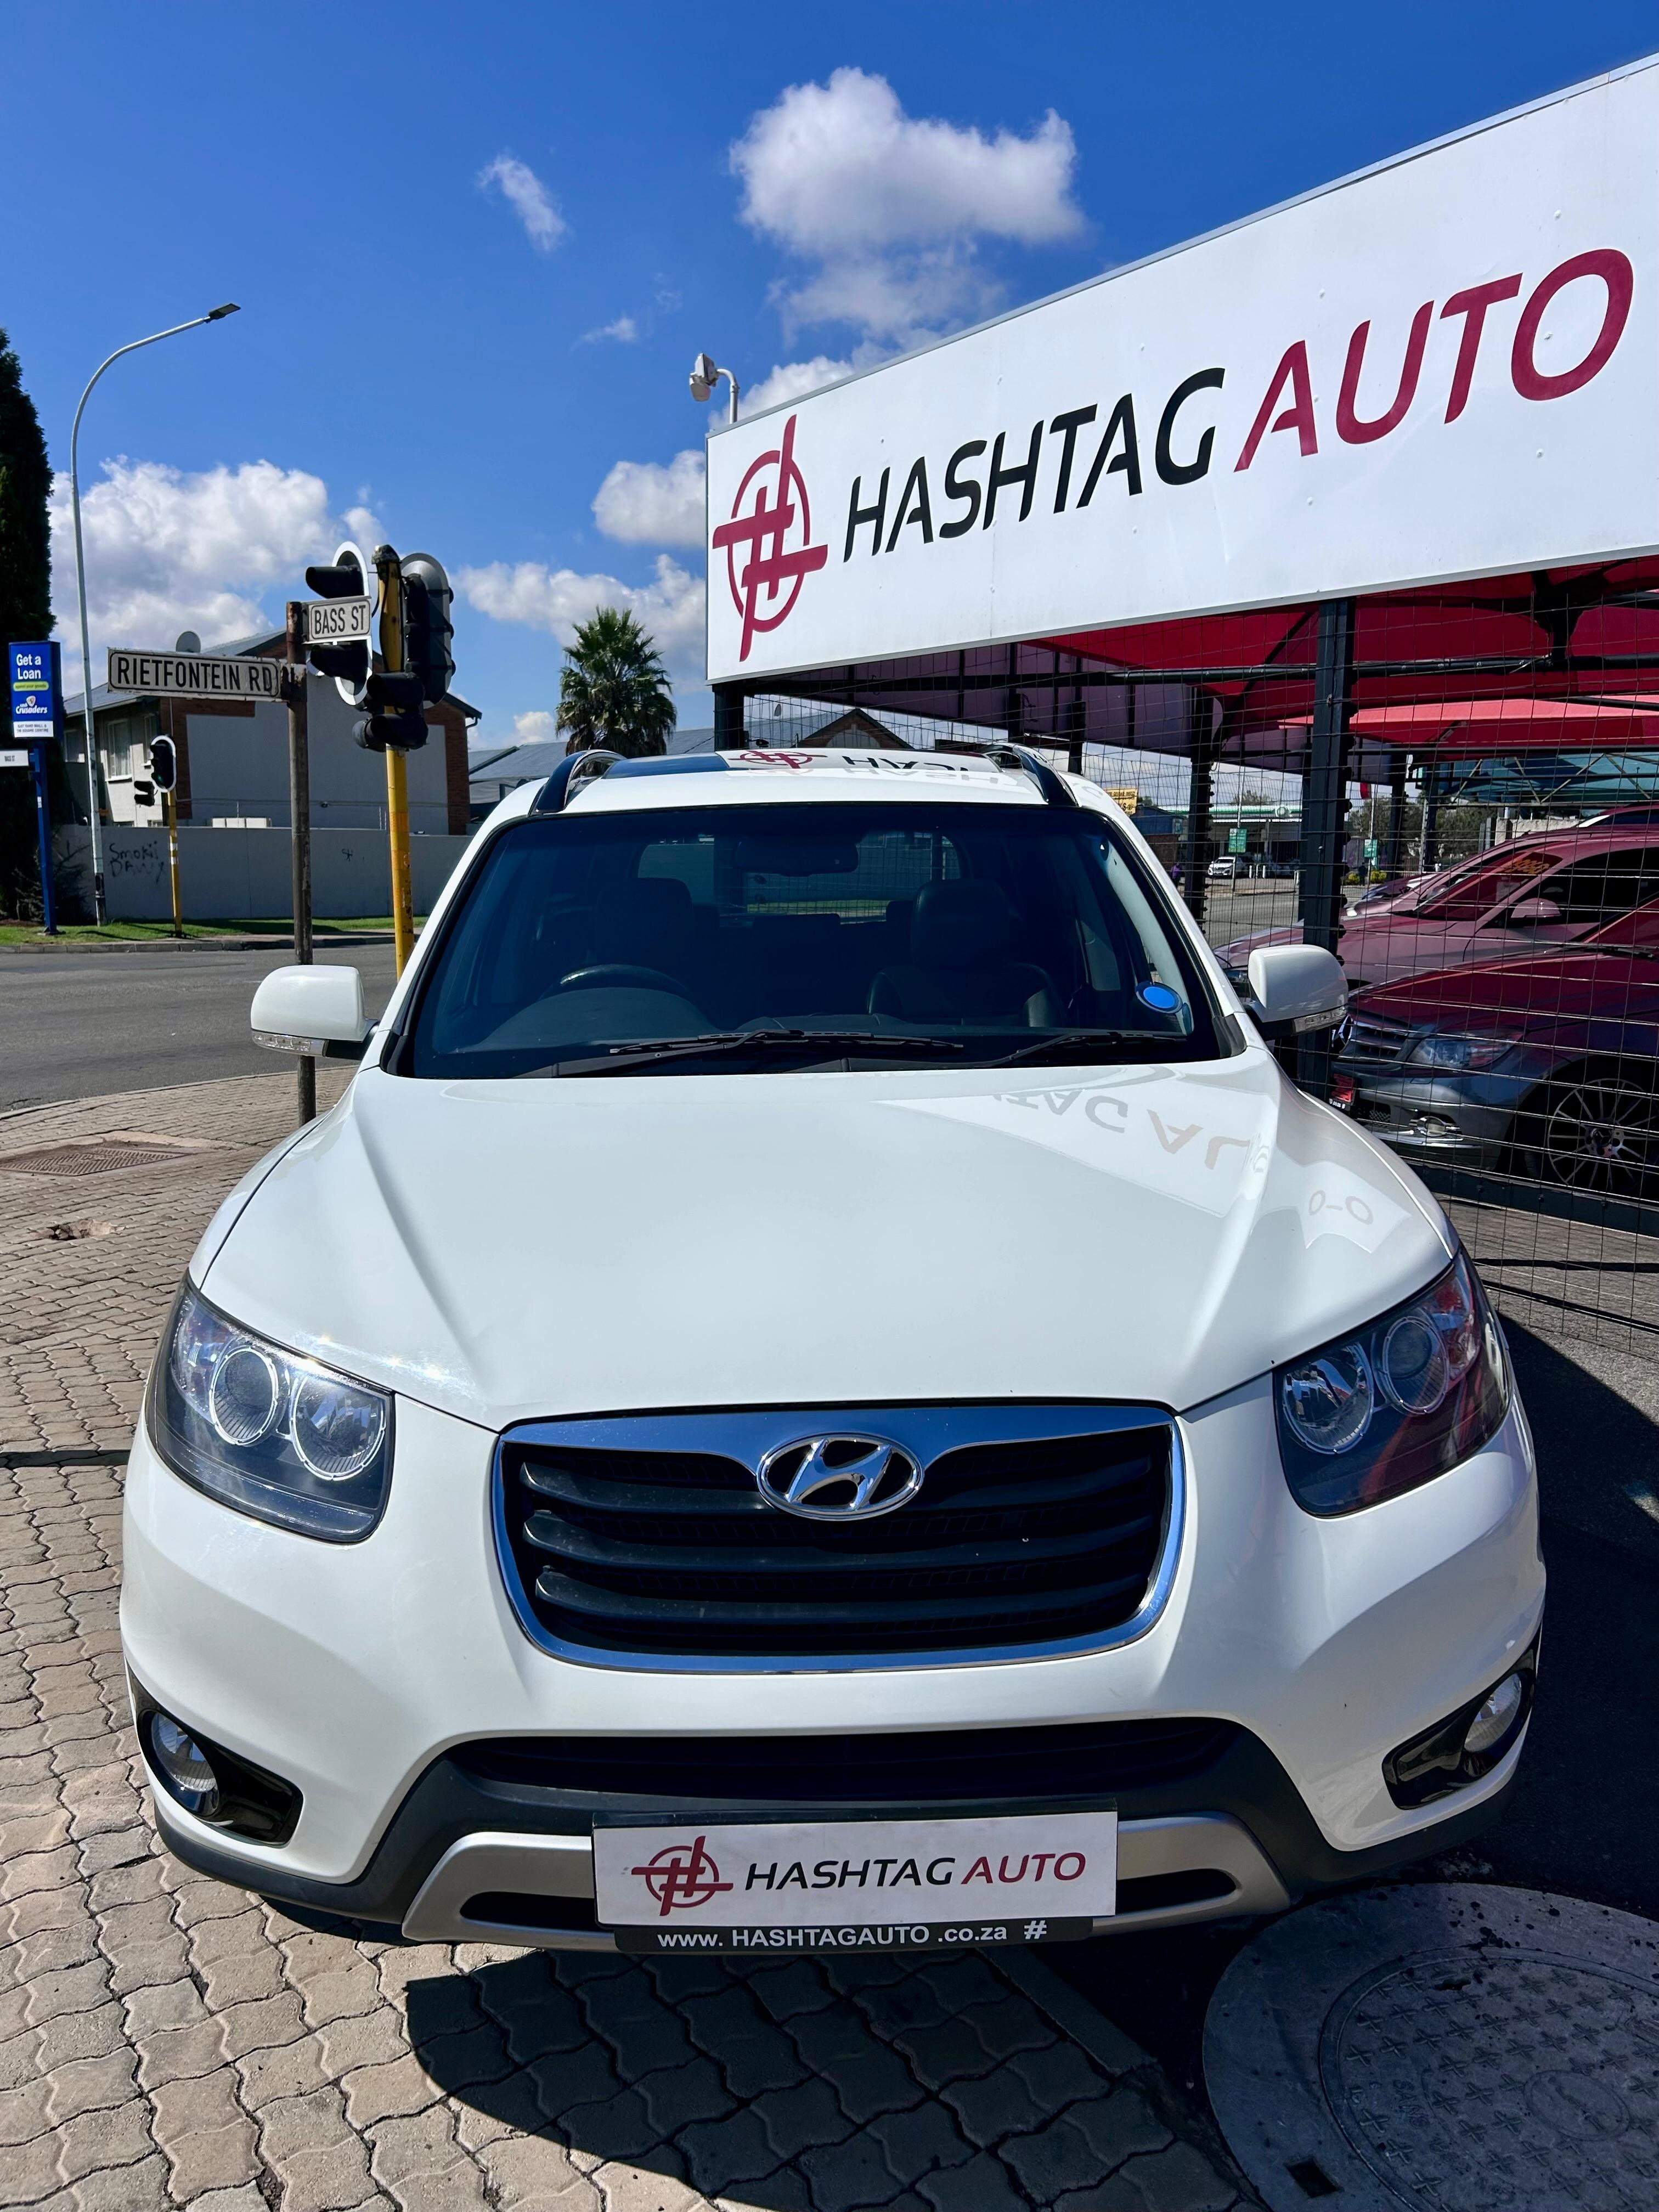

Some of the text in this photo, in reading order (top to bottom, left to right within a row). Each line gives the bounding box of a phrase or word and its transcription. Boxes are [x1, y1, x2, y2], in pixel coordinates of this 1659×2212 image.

[843, 249, 1634, 563] HASHTAG AUTO
[314, 605, 366, 635] BASS ST
[16, 653, 42, 666] Get a
[17, 667, 41, 680] Loan
[117, 657, 273, 693] RIETFONTEIN RD
[15, 705, 48, 714] Crusaders
[745, 1852, 1086, 1891] HASHTAG AUTO
[657, 1920, 1047, 1947] www. HASHTAGAUTO .co.za #
